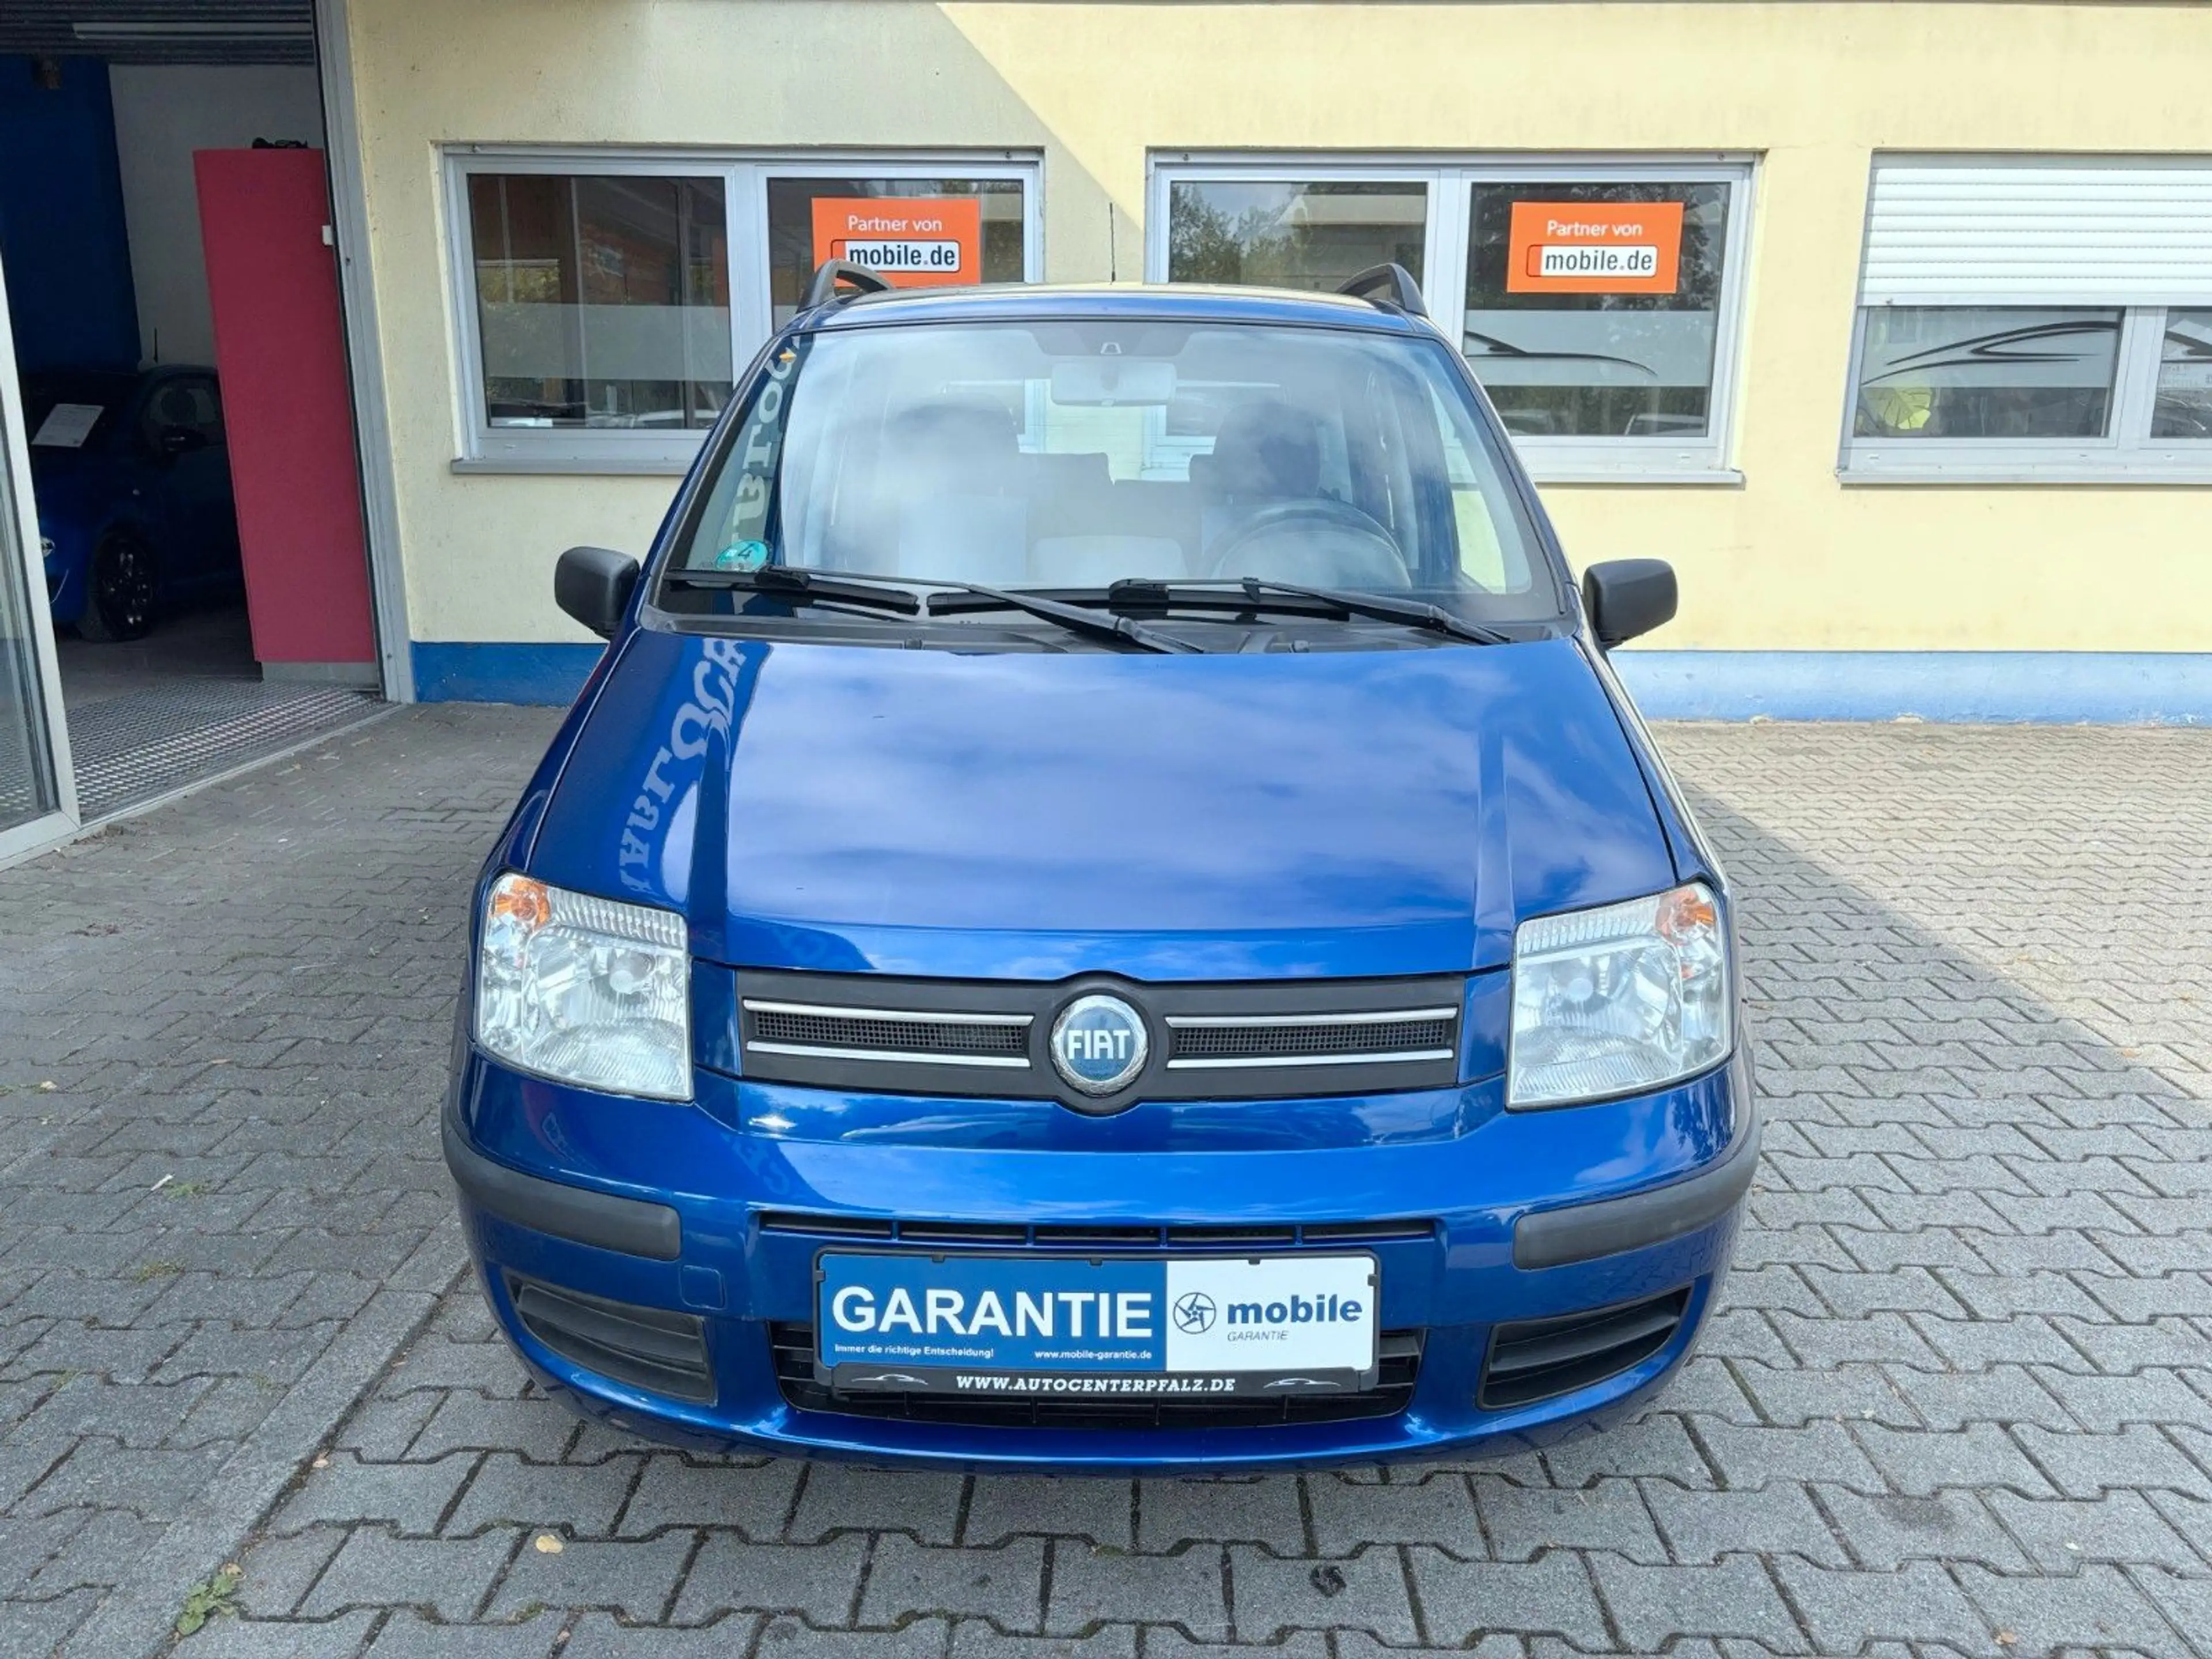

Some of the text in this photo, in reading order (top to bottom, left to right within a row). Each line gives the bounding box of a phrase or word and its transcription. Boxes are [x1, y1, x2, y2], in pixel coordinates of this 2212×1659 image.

[848, 215, 942, 232] Partner von
[1547, 219, 1643, 237] Partner von
[849, 244, 956, 266] mobile.de
[1545, 249, 1652, 271] mobile.de
[737, 543, 755, 560] 4
[1067, 1029, 1130, 1059] FIAT
[832, 1285, 1152, 1338] GARANTIE
[1228, 1294, 1362, 1324] mobile
[1228, 1330, 1289, 1342] GARANTIE
[835, 1343, 994, 1358] Immer die richtige Entscheidung!
[1035, 1350, 1152, 1360] www.mobile-garantie.de
[956, 1375, 1236, 1392] WWW.AUTOCENTERPFALZ.DE
